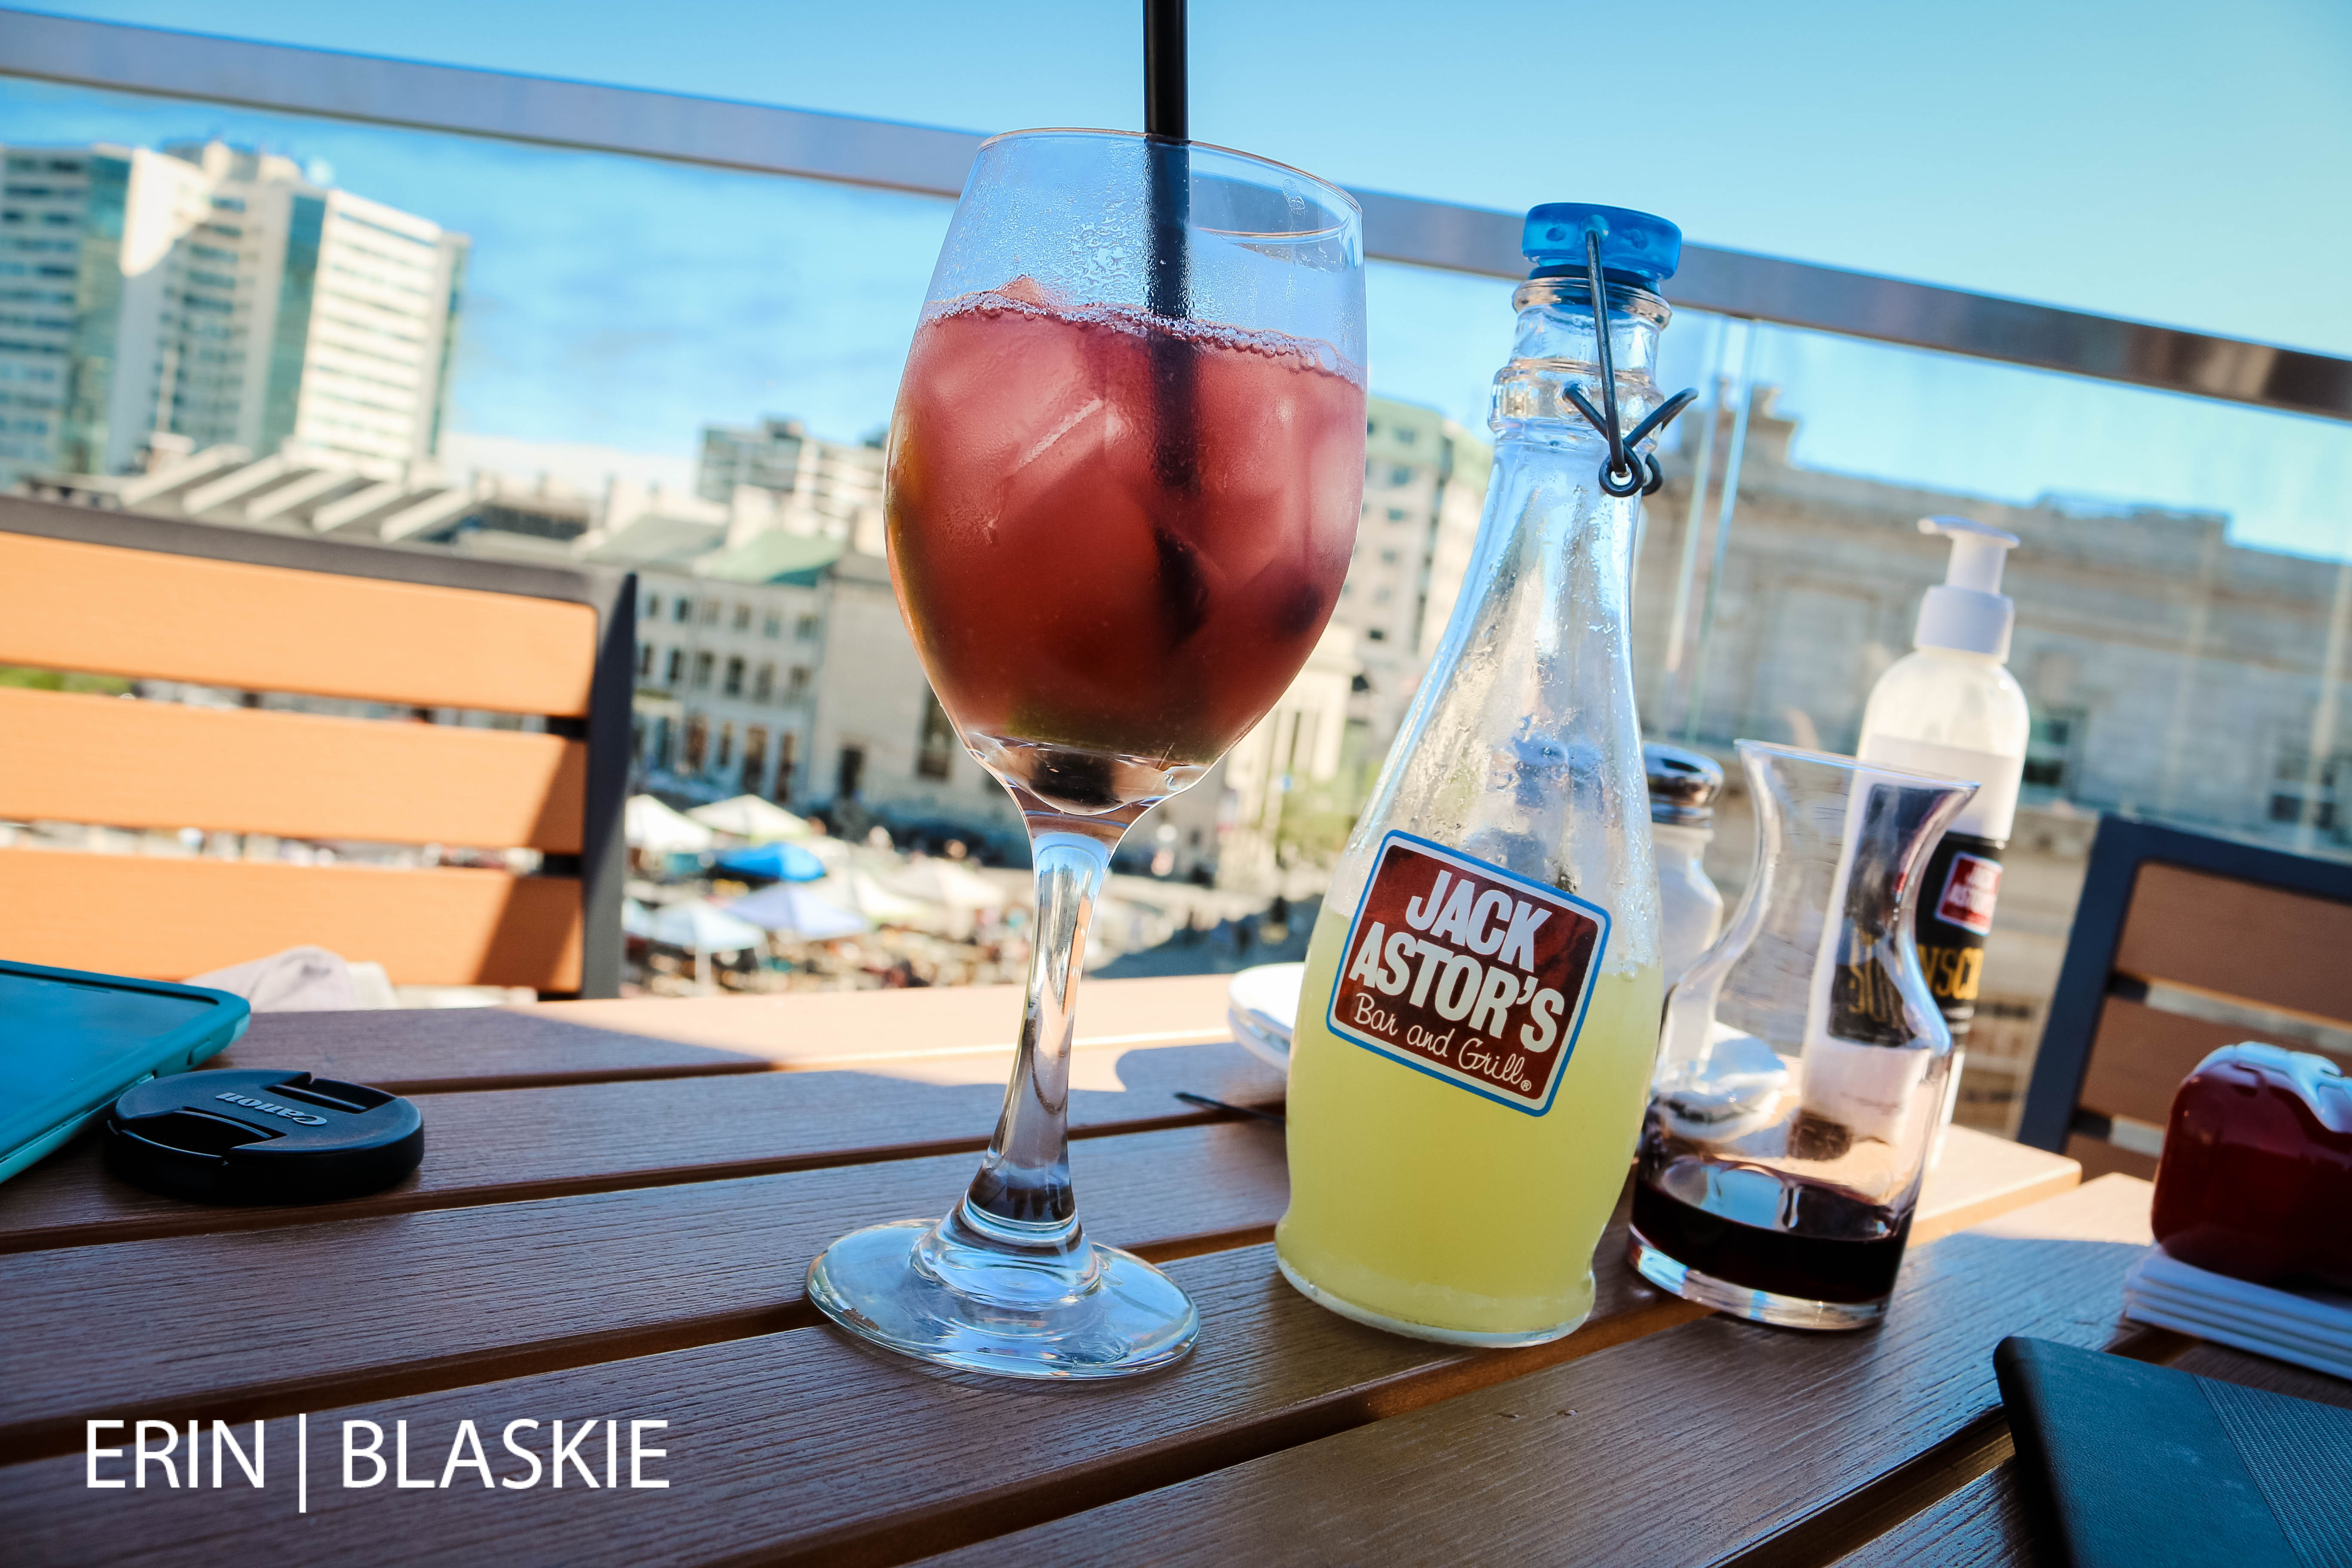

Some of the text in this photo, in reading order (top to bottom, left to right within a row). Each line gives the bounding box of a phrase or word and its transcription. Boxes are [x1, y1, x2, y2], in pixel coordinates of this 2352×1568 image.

[1405, 869, 1553, 973] JACK
[1348, 921, 1565, 1053] ASTOR'S
[1354, 992, 1398, 1036] Bar
[1407, 1025, 1455, 1057] and
[215, 1091, 328, 1126] Canon
